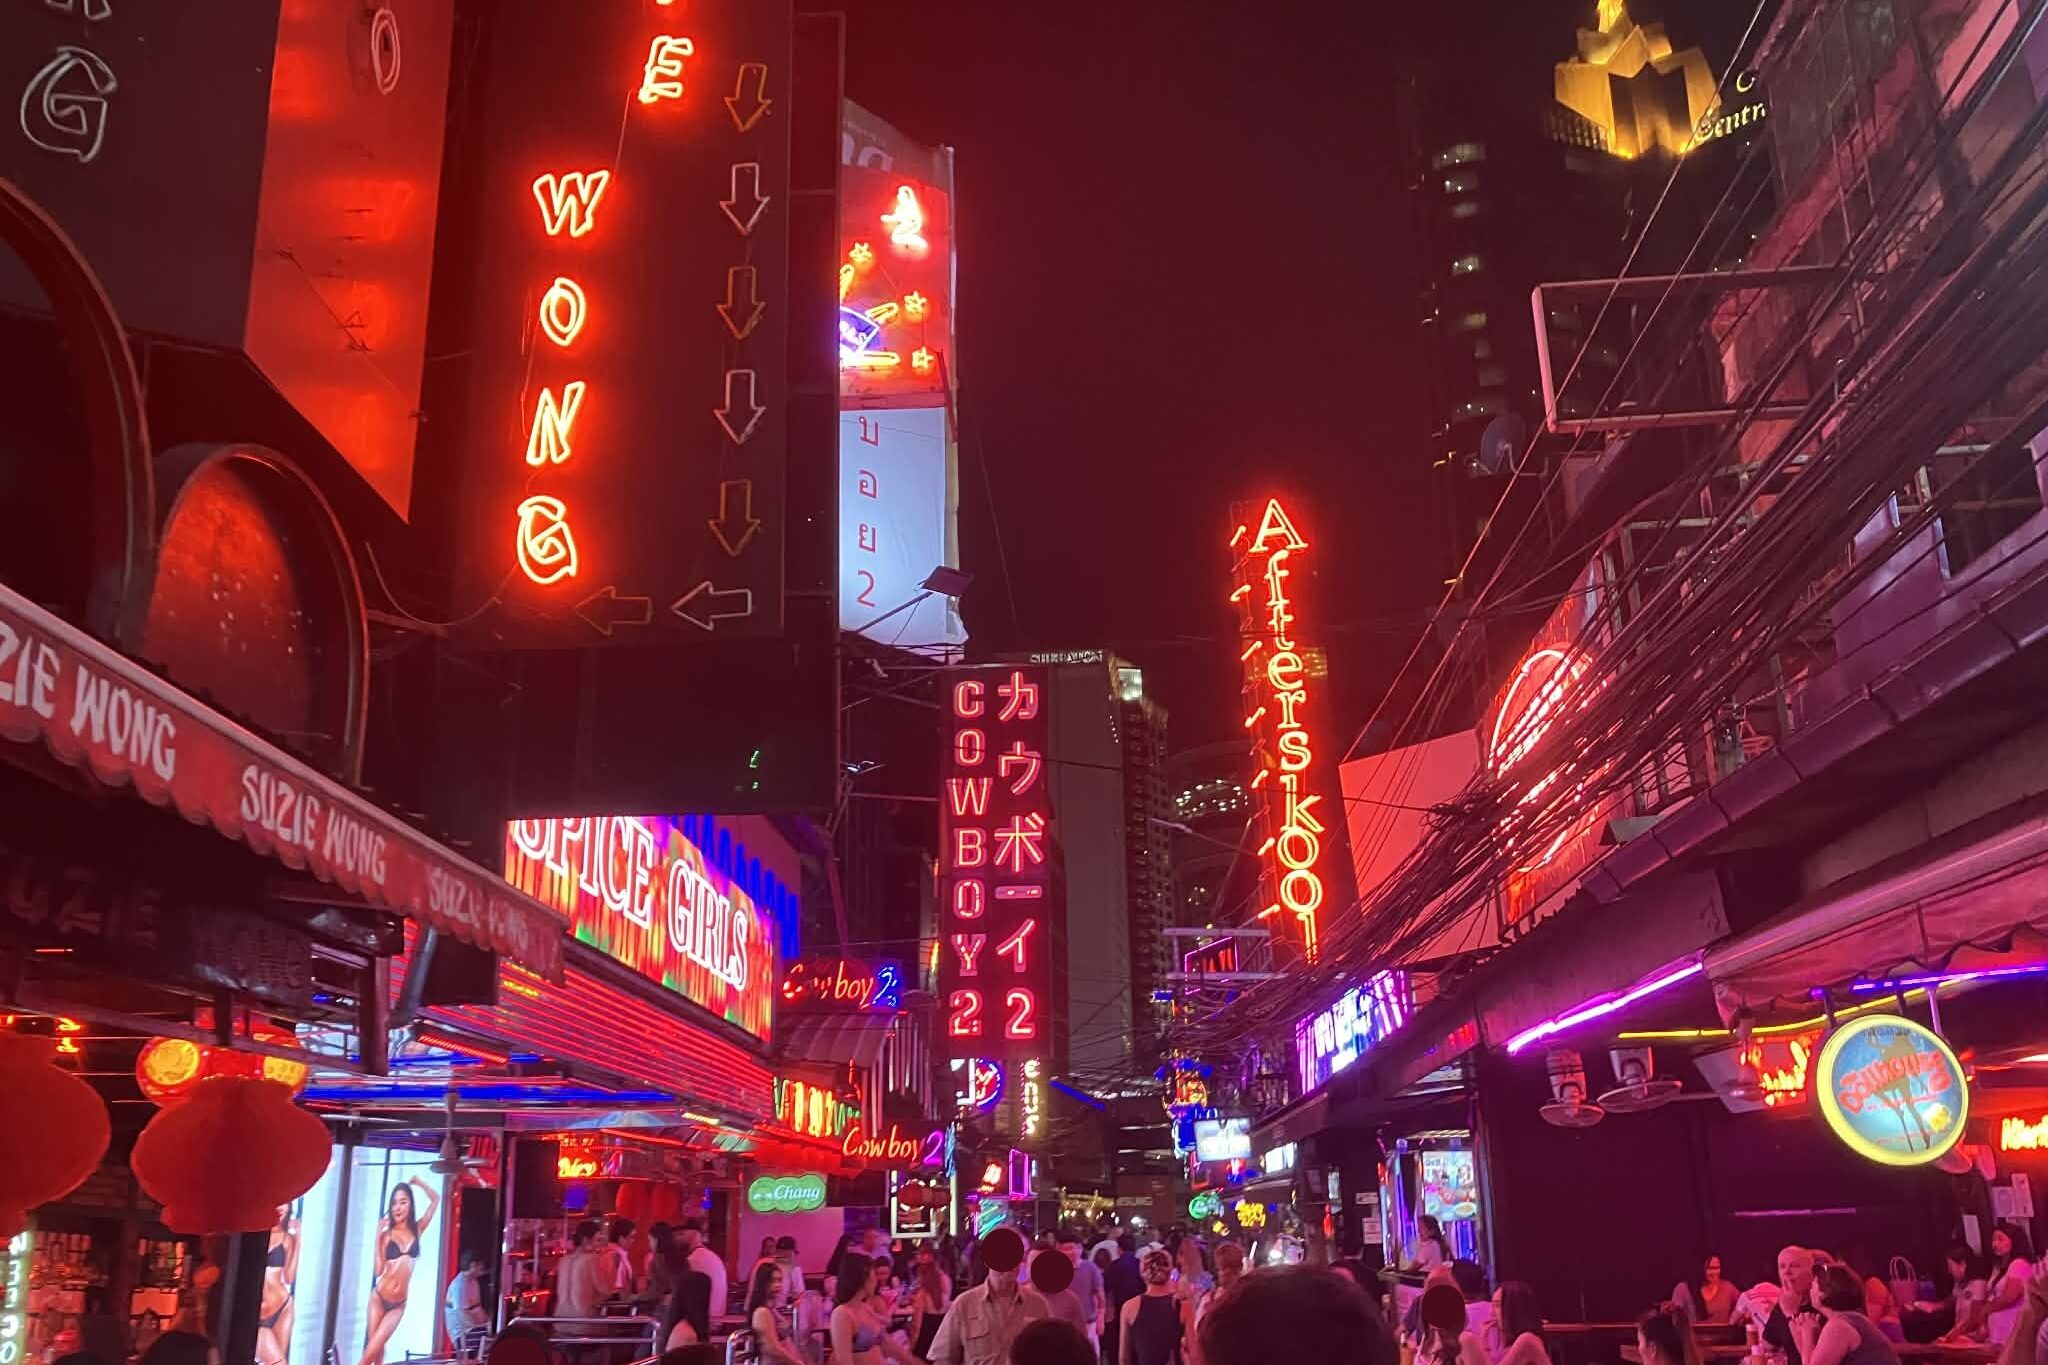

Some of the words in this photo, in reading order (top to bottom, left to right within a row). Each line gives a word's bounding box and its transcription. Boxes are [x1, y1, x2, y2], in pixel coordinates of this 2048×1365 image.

[516, 169, 609, 585] WONG
[70, 665, 176, 782] WONG
[1249, 498, 1324, 965] Afterskool
[240, 764, 320, 851] SUZIE
[323, 806, 386, 885] WONG
[667, 857, 749, 991] GIRLS
[783, 960, 874, 1010] Cwboy
[871, 964, 897, 1007] 2
[773, 1182, 821, 1201] Chang
[842, 1123, 925, 1169] Cowboy
[923, 1130, 945, 1165] 2
